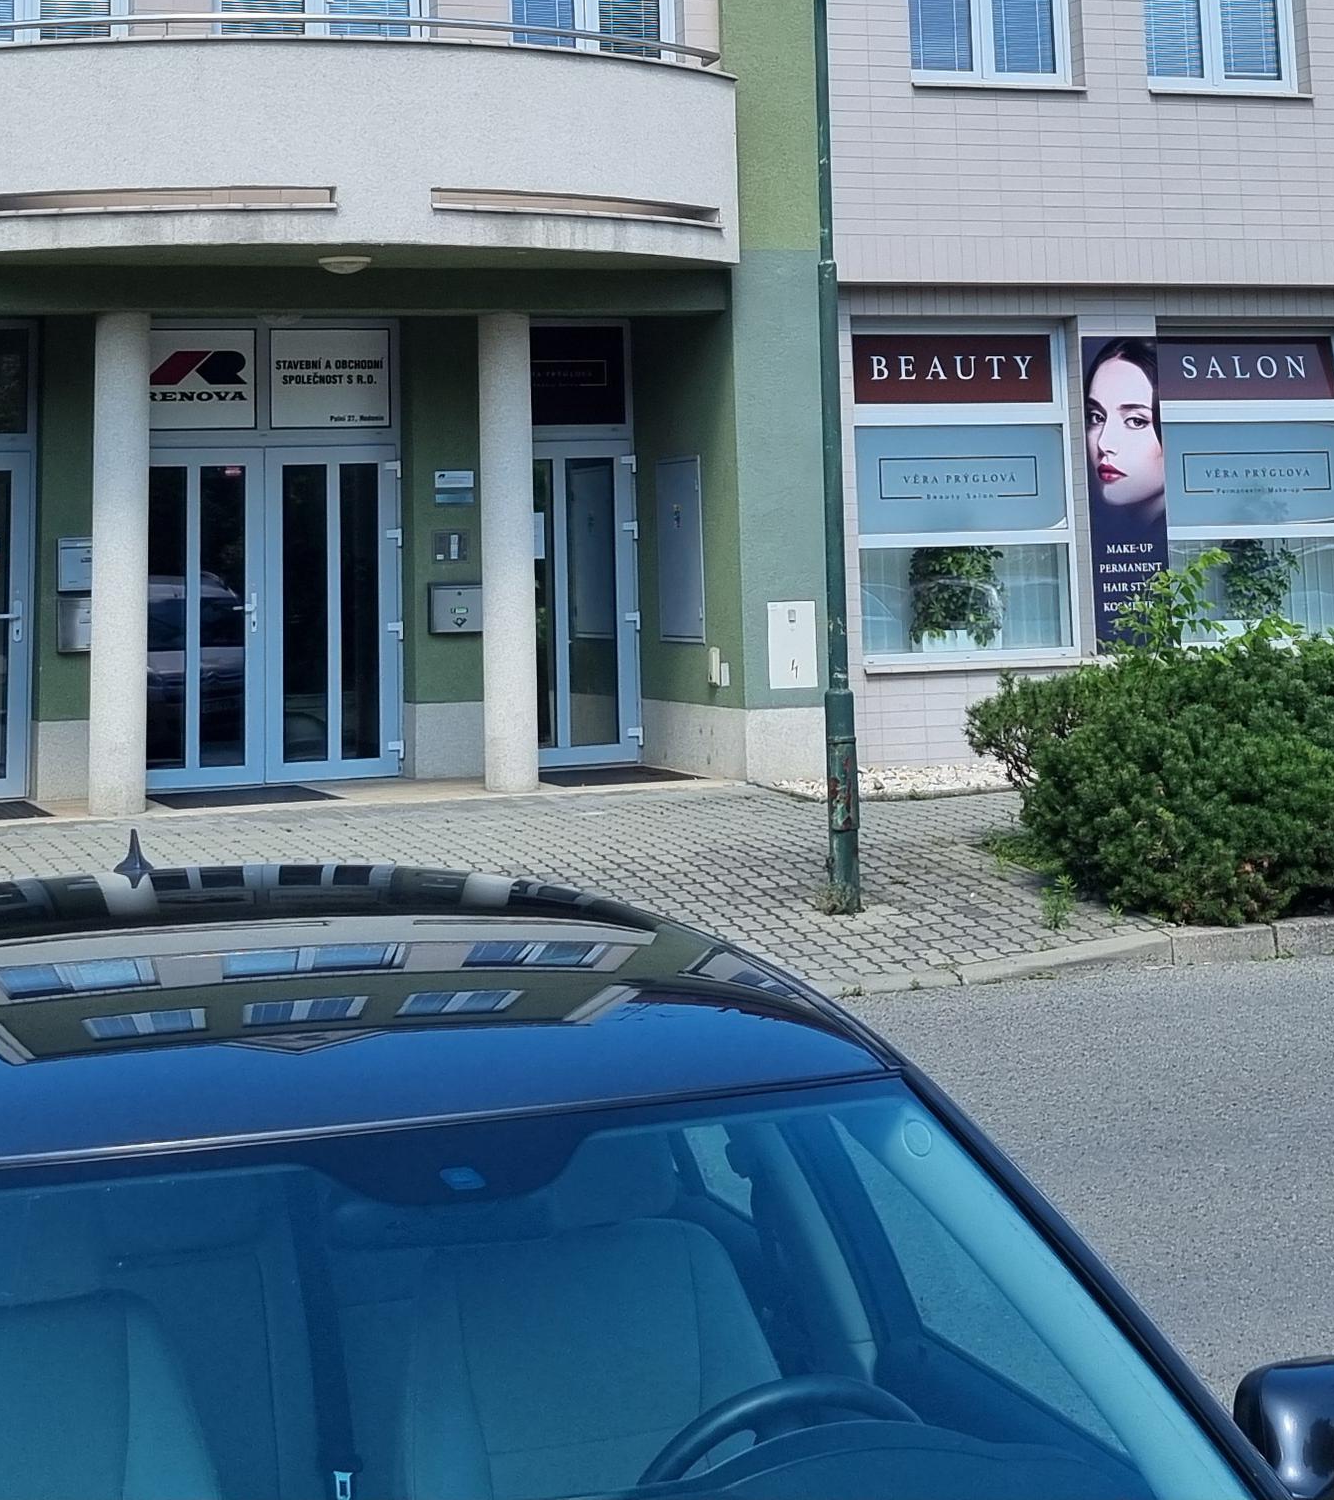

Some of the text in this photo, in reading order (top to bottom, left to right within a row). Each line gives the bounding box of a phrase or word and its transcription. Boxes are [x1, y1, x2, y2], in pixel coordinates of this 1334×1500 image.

[275, 357, 384, 370] STAVEBNÍ A OBCHODNÍ
[870, 355, 1033, 381] BEAUTY
[1181, 355, 1306, 379] SALON
[281, 372, 344, 385] SPOLEČNOST
[346, 375, 354, 385] S
[903, 471, 1017, 485] VĚRA PRÝGLOVÁ
[1205, 467, 1311, 479] VĚRA PRÝGLOVÁ
[1106, 543, 1154, 554] MAKE-UP
[1099, 562, 1163, 574] PERMANENT
[1102, 582, 1128, 593] HAIR
